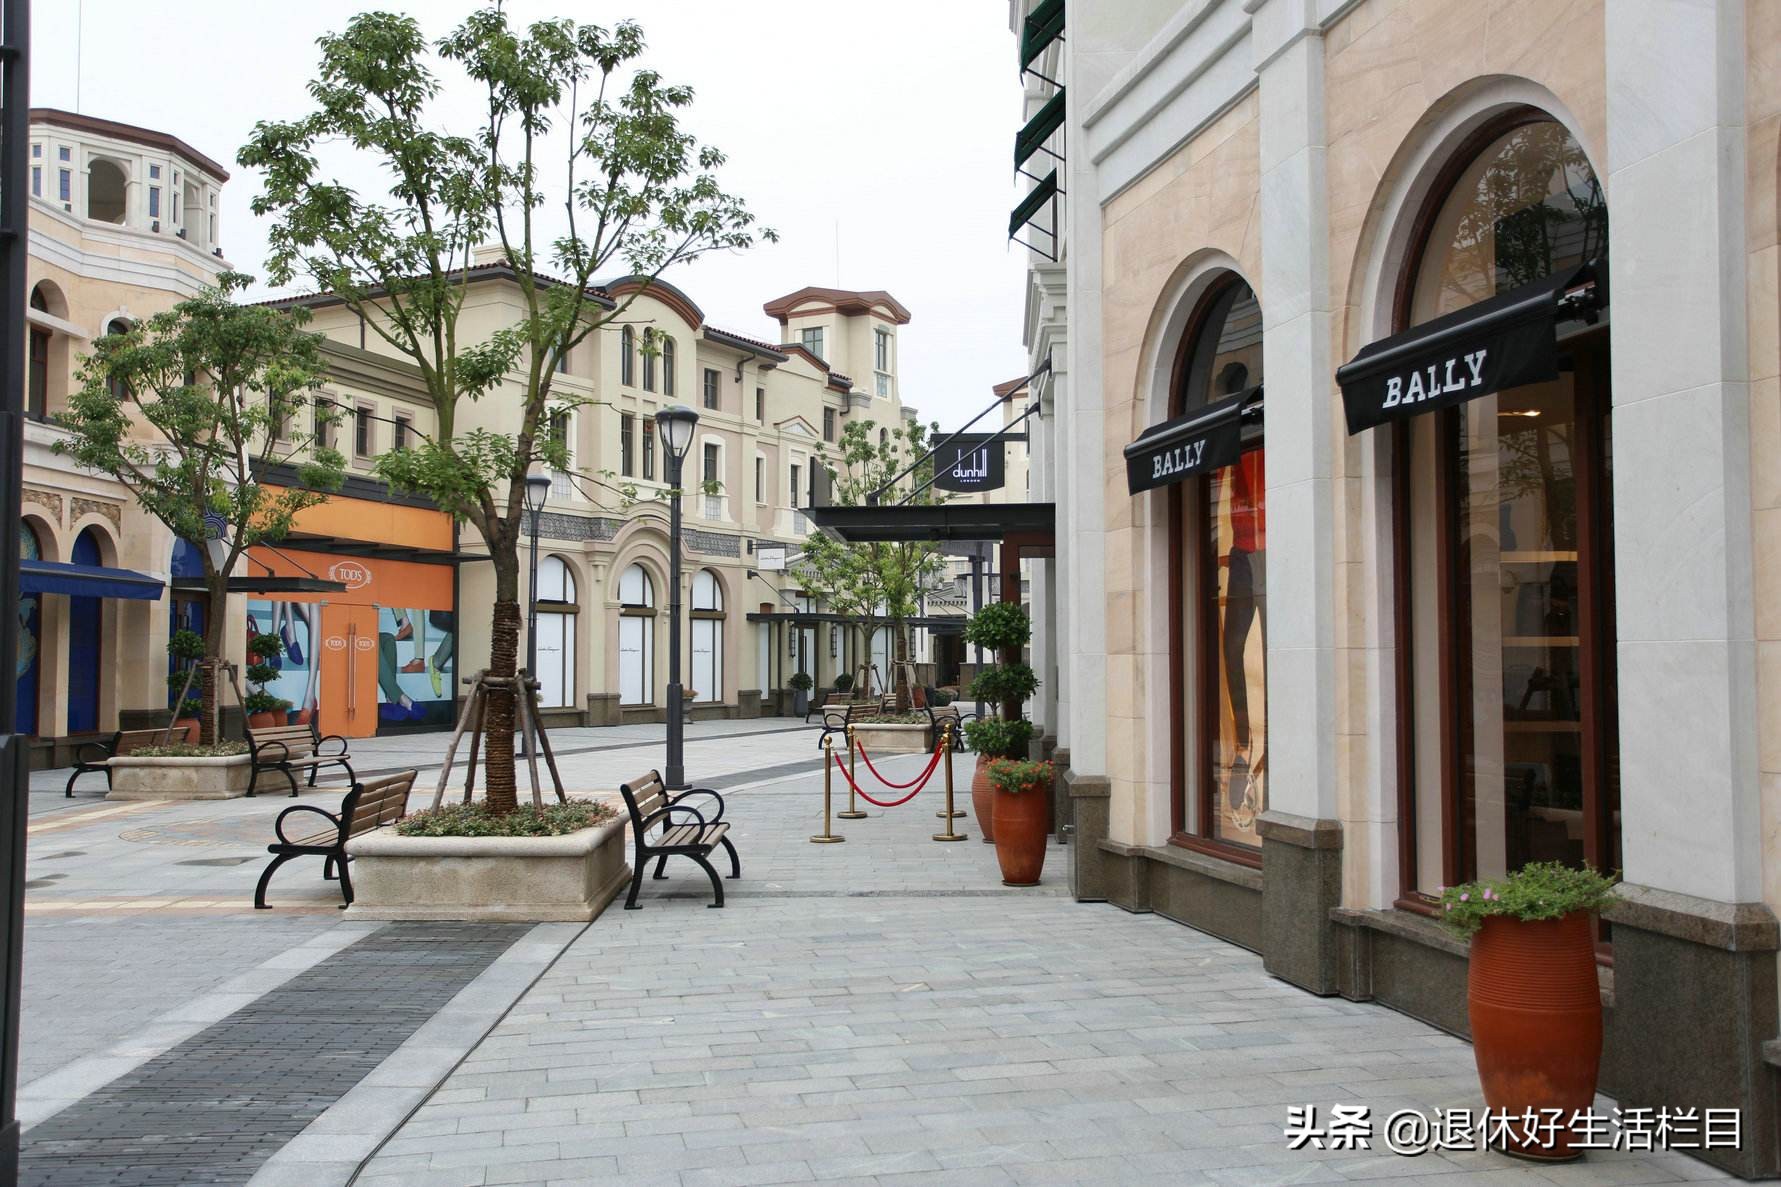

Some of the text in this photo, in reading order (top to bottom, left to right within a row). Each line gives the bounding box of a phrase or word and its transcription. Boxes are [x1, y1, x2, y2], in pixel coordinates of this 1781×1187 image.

[1382, 349, 1487, 409] BALLY
[952, 448, 987, 478] dunhill
[1152, 439, 1206, 479] BALLY
